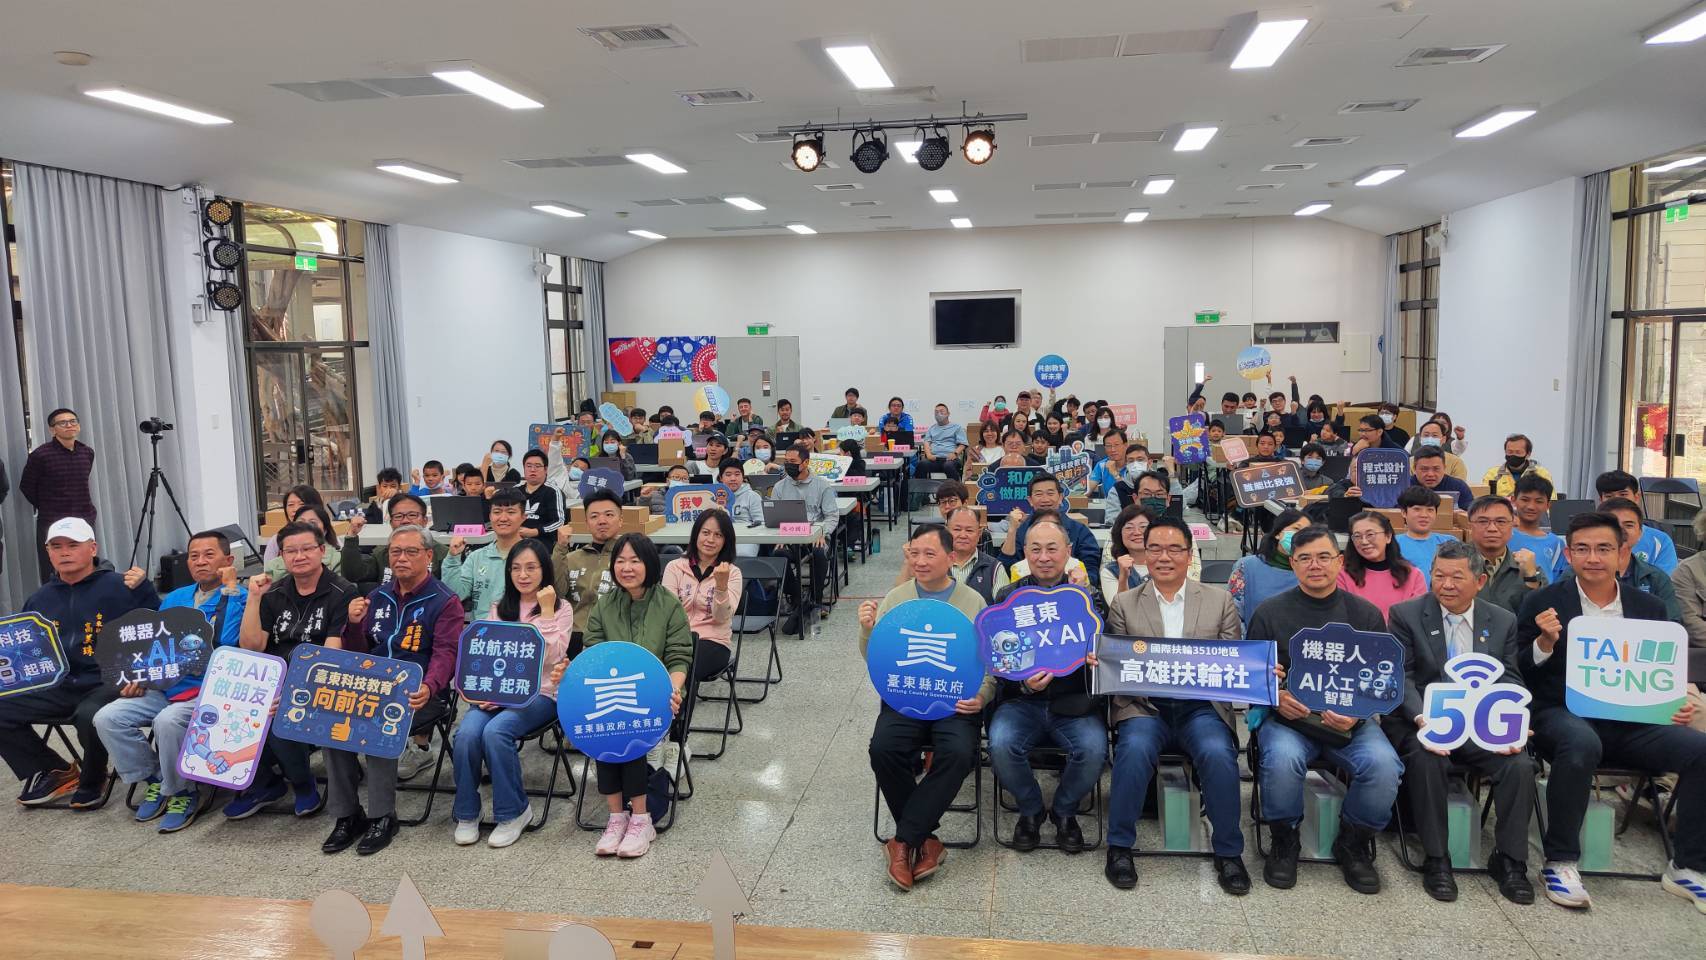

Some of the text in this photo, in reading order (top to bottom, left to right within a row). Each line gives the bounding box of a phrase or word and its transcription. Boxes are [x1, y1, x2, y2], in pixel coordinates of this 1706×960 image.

[1362, 462, 1406, 473] 程式設計
[1366, 473, 1399, 485] 我最行
[680, 497, 691, 509] 我
[1012, 601, 1061, 628] 臺東
[119, 621, 172, 642] 機器人
[1060, 622, 1086, 646] AI
[149, 638, 175, 665] AI
[468, 638, 536, 660] 啟航科技
[1150, 642, 1240, 658] 國際扶輪3510地區
[1302, 639, 1367, 665] 機器人
[24, 659, 56, 677] 起飛
[116, 665, 181, 687] 人工智慧
[227, 657, 268, 684] 和AI
[1119, 657, 1251, 690] 高雄扶輪社
[213, 677, 268, 708] 做朋友
[313, 668, 394, 697] 臺東科技教育
[463, 675, 531, 696] 臺東 起飛
[887, 673, 964, 695] 臺東縣政府
[312, 687, 380, 719] 向前行
[1323, 691, 1354, 707] 智慧
[1424, 688, 1526, 746] 5G
